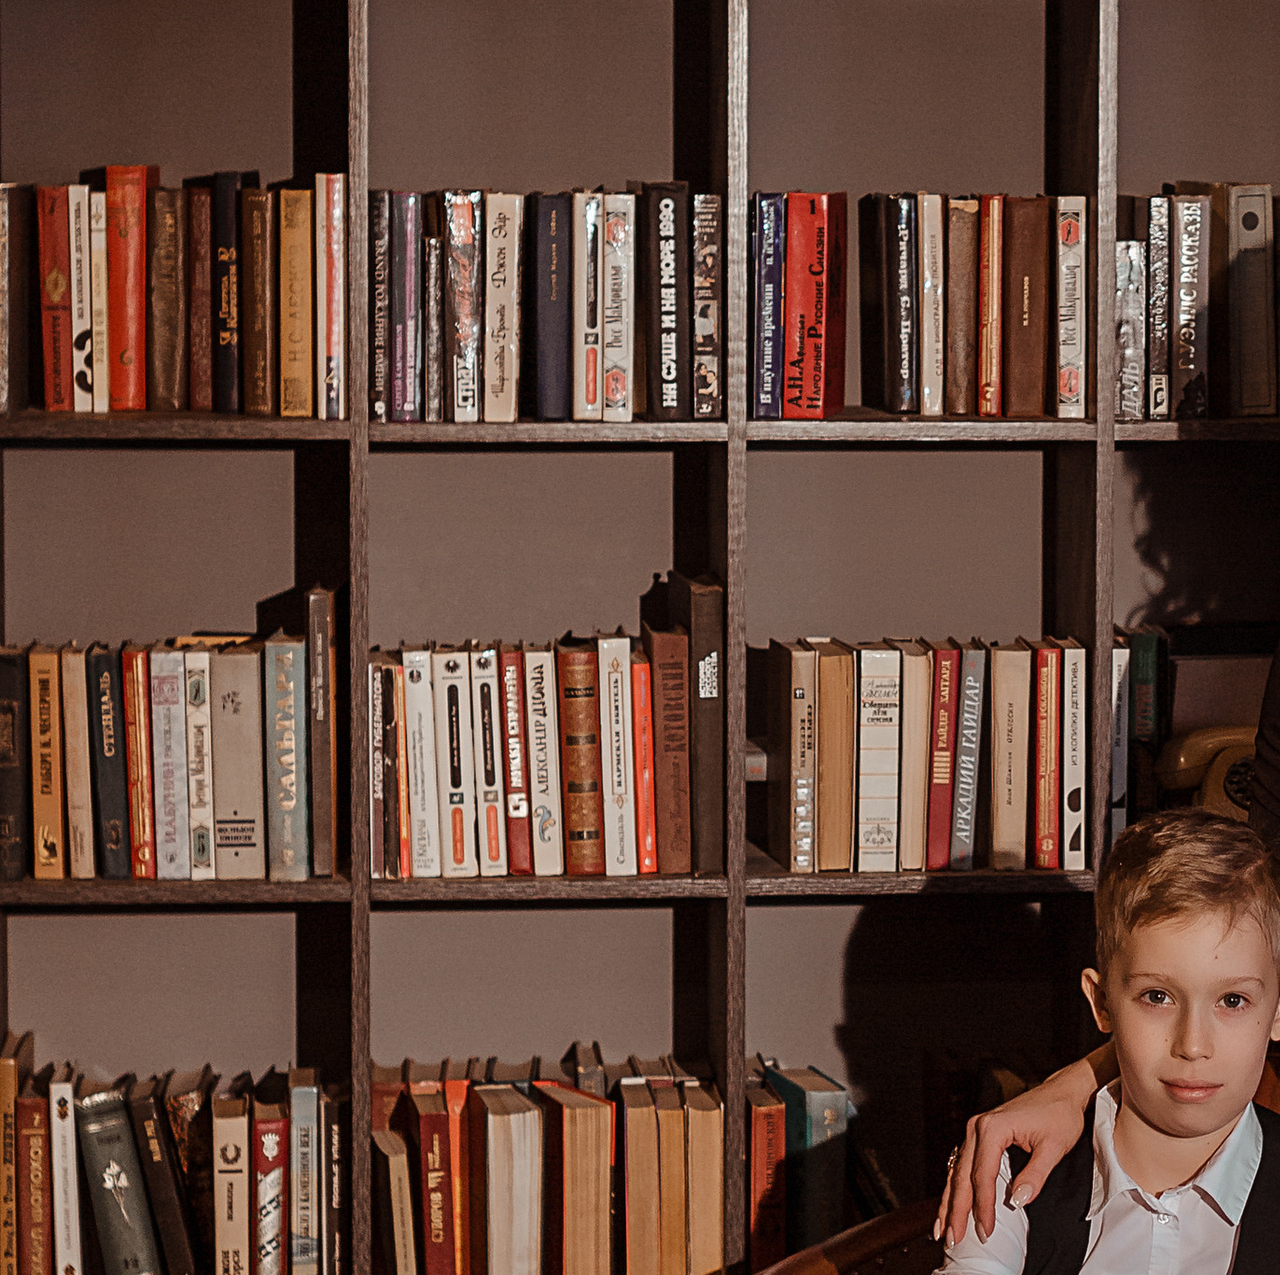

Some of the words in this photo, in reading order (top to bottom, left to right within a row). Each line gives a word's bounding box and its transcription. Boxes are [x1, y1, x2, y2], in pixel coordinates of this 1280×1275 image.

[491, 211, 509, 238] Эйр
[658, 197, 674, 236] 1990
[1181, 201, 1200, 283] РАССКАЗЫ
[659, 239, 675, 284] МОРЕ
[660, 287, 675, 311] НА
[661, 314, 676, 327] И
[761, 282, 775, 337] времени
[605, 329, 622, 348] Росс
[661, 332, 676, 380] СУШЕ
[662, 381, 677, 407] НА
[99, 670, 114, 756] СТЕНДАЛЬ
[529, 663, 547, 718] ДЮМА
[658, 661, 686, 752] КОТОВСКИЙ
[961, 675, 980, 749] ГАЙДАР
[275, 650, 296, 811] САЛЬГАРИ
[534, 719, 548, 796] АЛЕКСАНДР
[956, 753, 974, 843] АРКАДИЙ
[29, 1135, 43, 1222] ШОЛОХОВ
